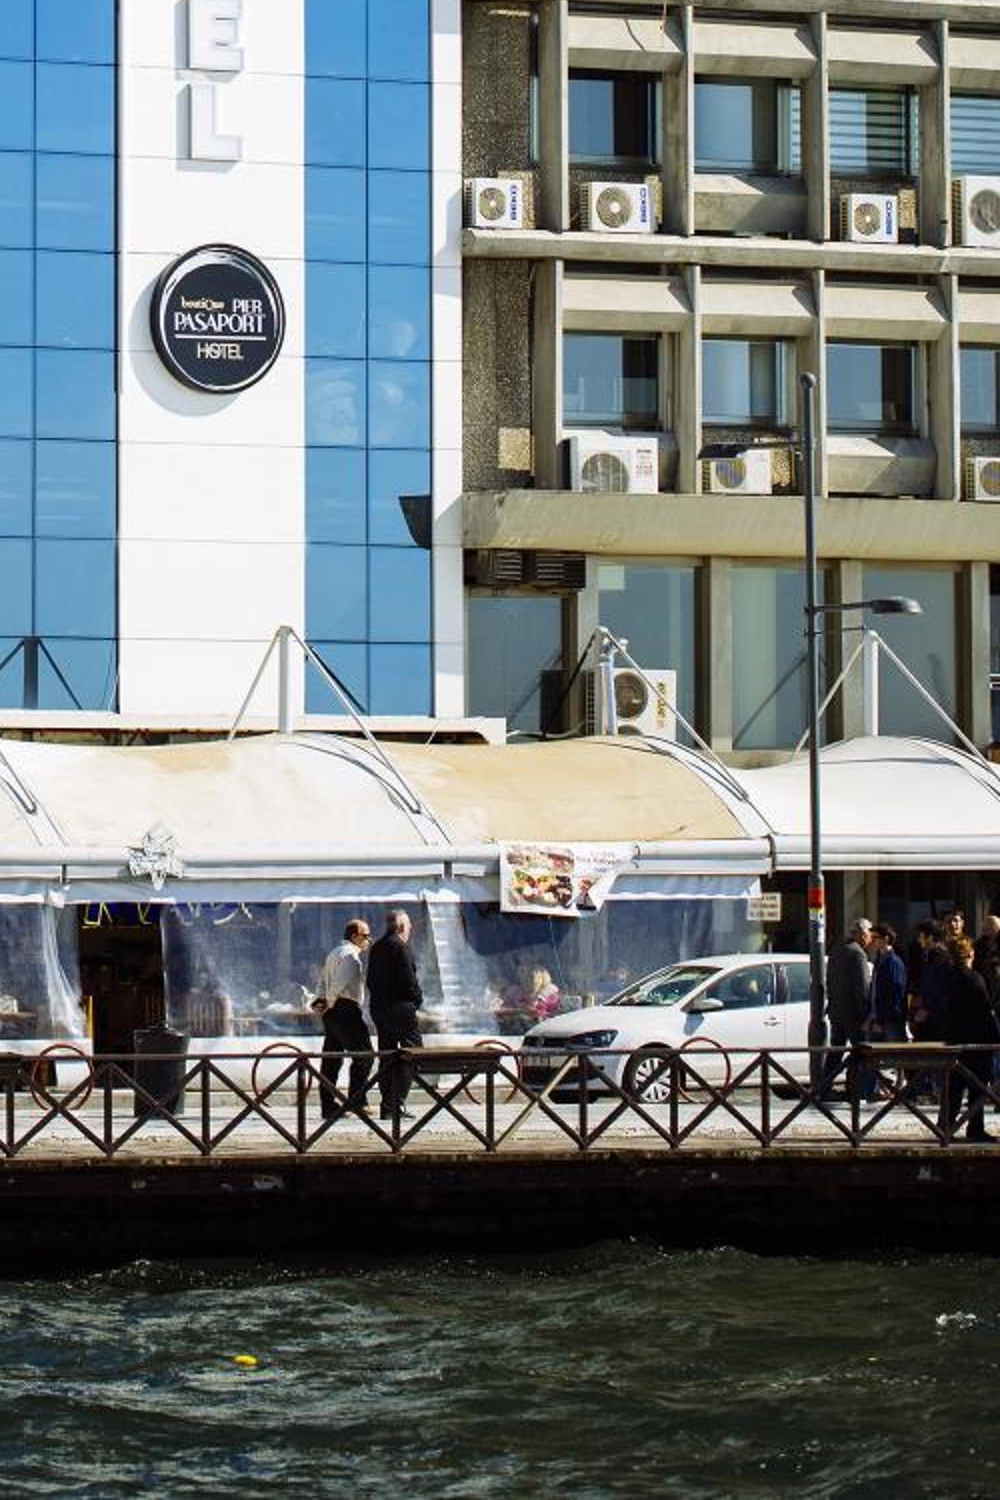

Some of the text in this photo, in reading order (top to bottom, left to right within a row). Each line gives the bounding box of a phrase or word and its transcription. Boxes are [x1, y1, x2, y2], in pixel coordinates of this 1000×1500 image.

[232, 299, 263, 313] PIER
[174, 311, 266, 333] PASAPORT
[196, 342, 244, 360] HOTEL
